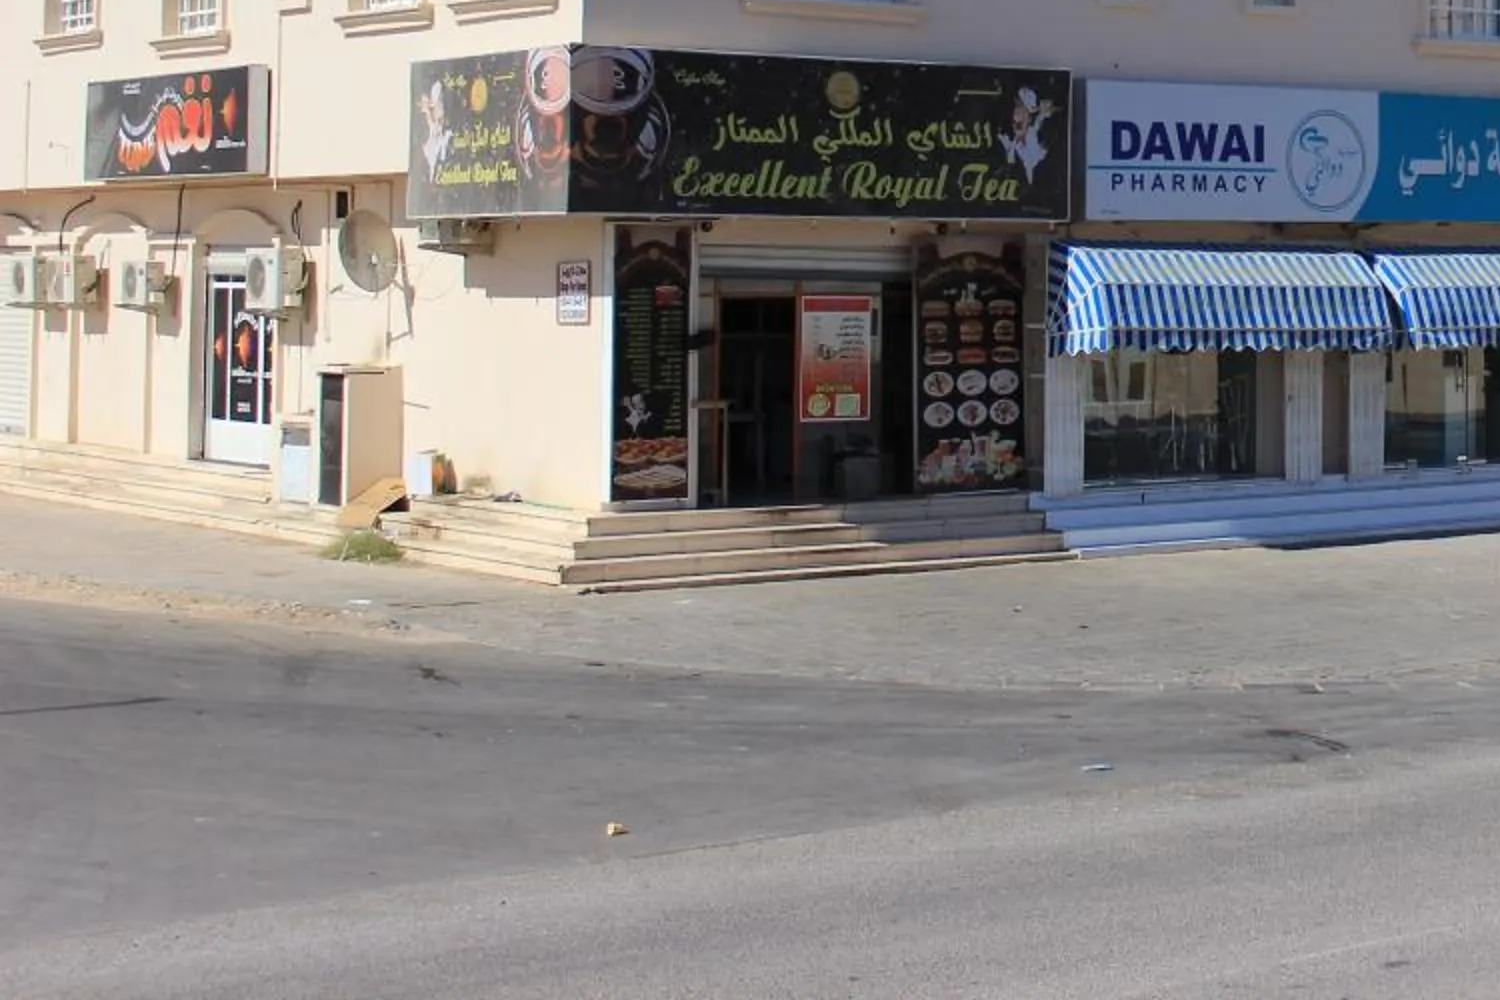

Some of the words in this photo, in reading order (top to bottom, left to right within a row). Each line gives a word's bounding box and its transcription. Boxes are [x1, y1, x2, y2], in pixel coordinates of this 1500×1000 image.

[712, 111, 799, 151] الممتاز
[812, 105, 893, 163] الملكي
[906, 119, 993, 161] الشاي
[1111, 120, 1265, 163] DAWAI
[673, 156, 834, 199] Excellent
[843, 160, 950, 209] Royal
[957, 162, 1020, 201] Tea
[1111, 173, 1265, 193] PHARMACY
[1399, 129, 1481, 196] دوائي
